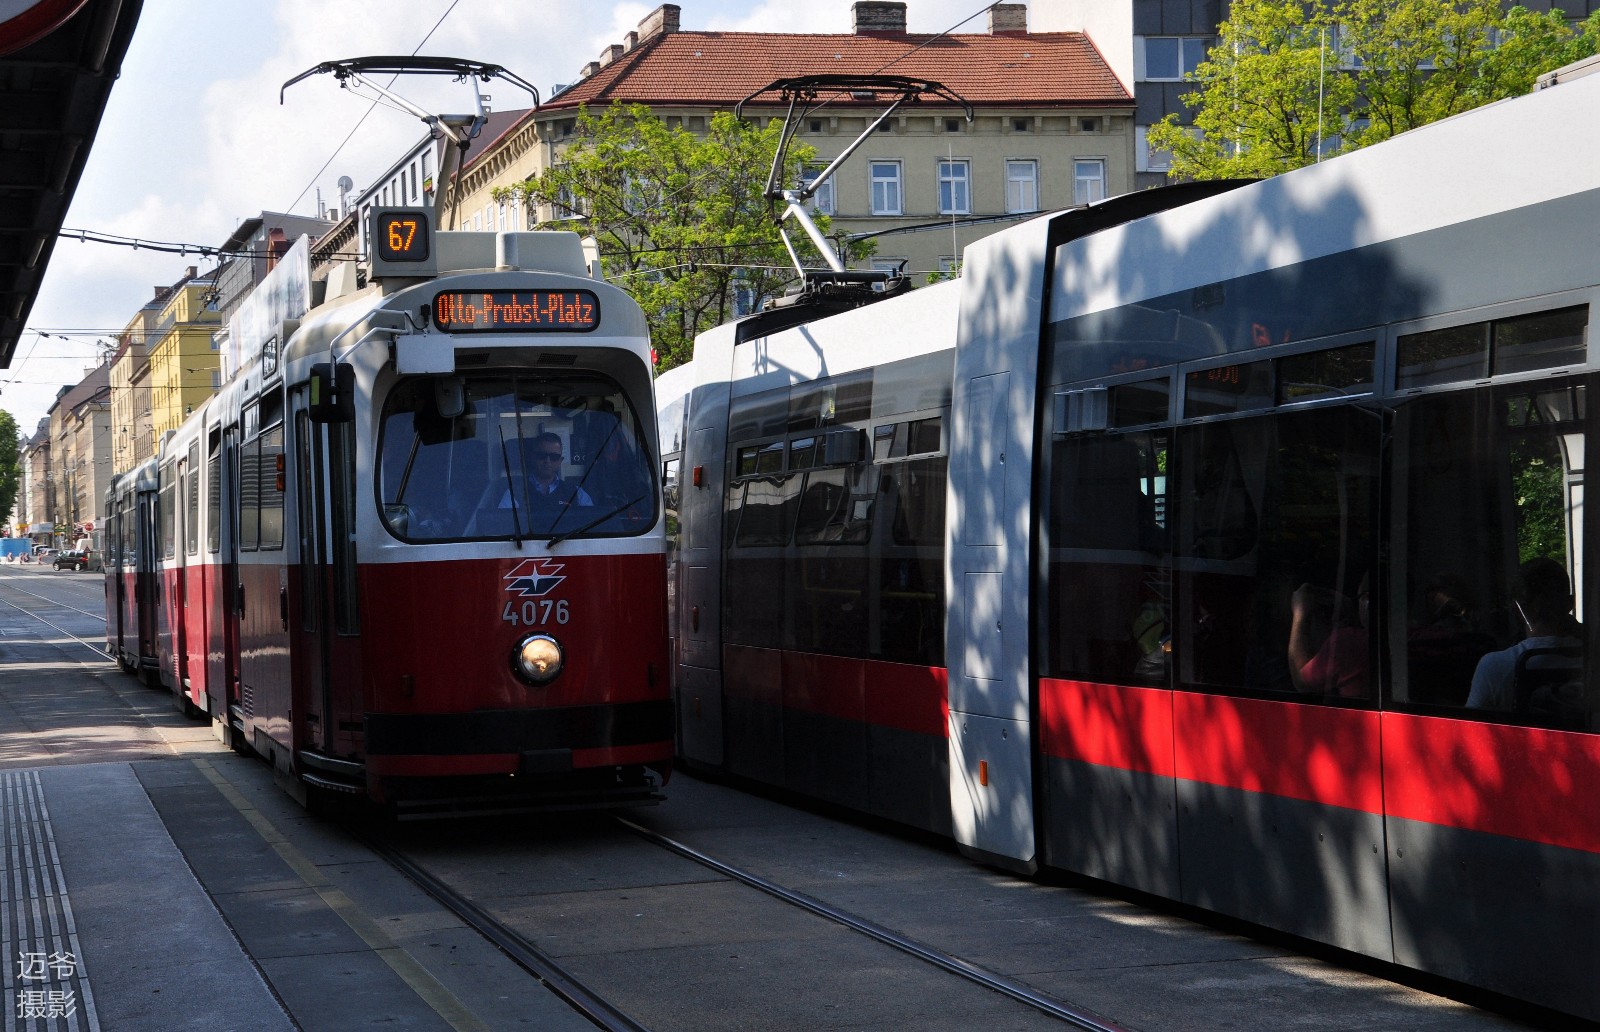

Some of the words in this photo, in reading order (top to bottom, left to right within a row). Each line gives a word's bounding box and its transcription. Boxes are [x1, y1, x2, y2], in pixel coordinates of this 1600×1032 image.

[388, 221, 416, 251] 67
[437, 294, 593, 323] Otto-Probst-Platz
[502, 599, 570, 626] 4076
